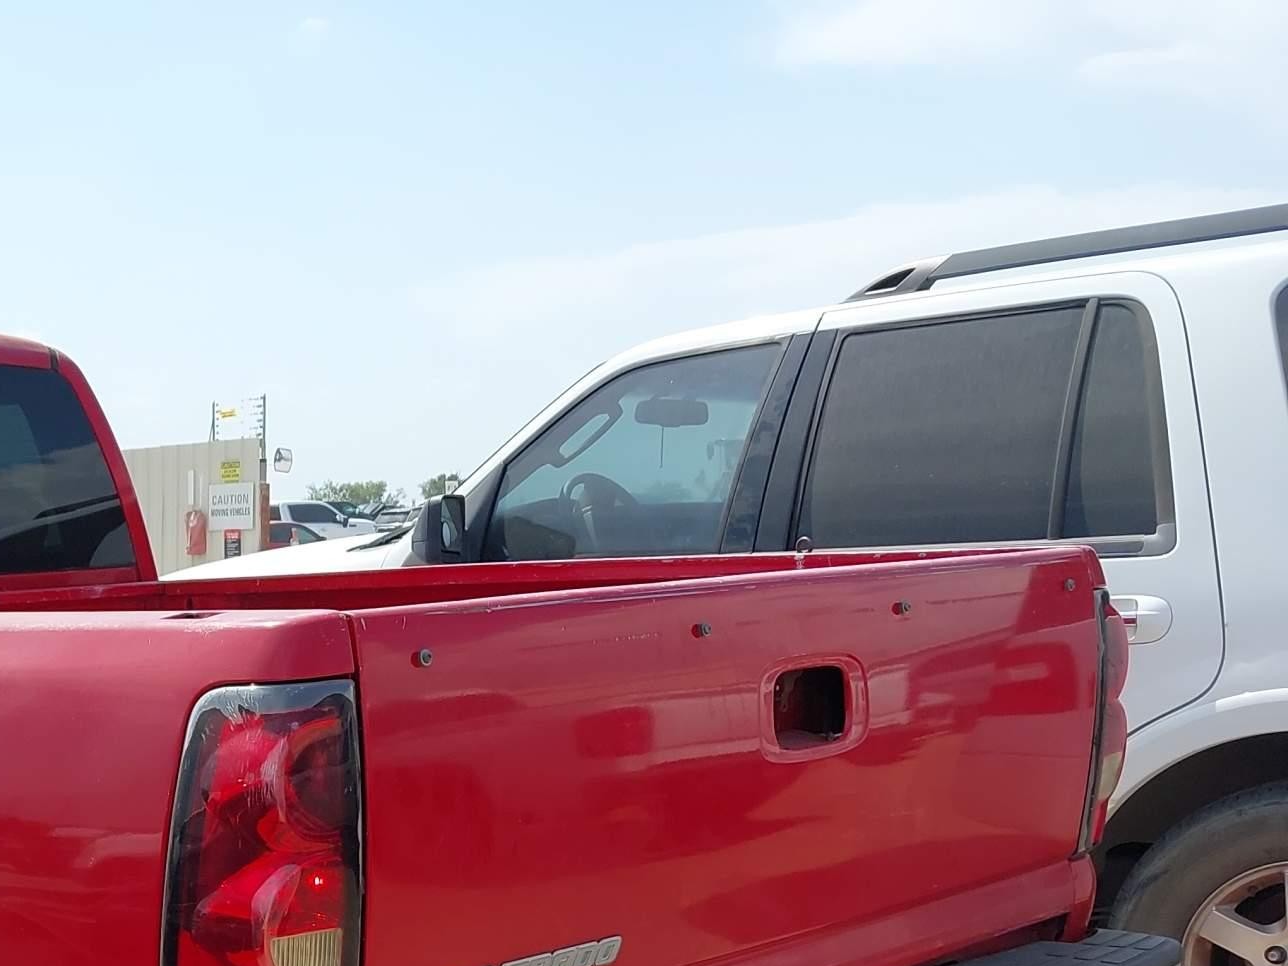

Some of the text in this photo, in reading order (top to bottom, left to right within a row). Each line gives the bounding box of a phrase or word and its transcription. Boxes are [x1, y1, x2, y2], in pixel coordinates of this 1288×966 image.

[212, 494, 249, 505] CAUTION
[211, 506, 251, 517] MOVING VEHICLES
